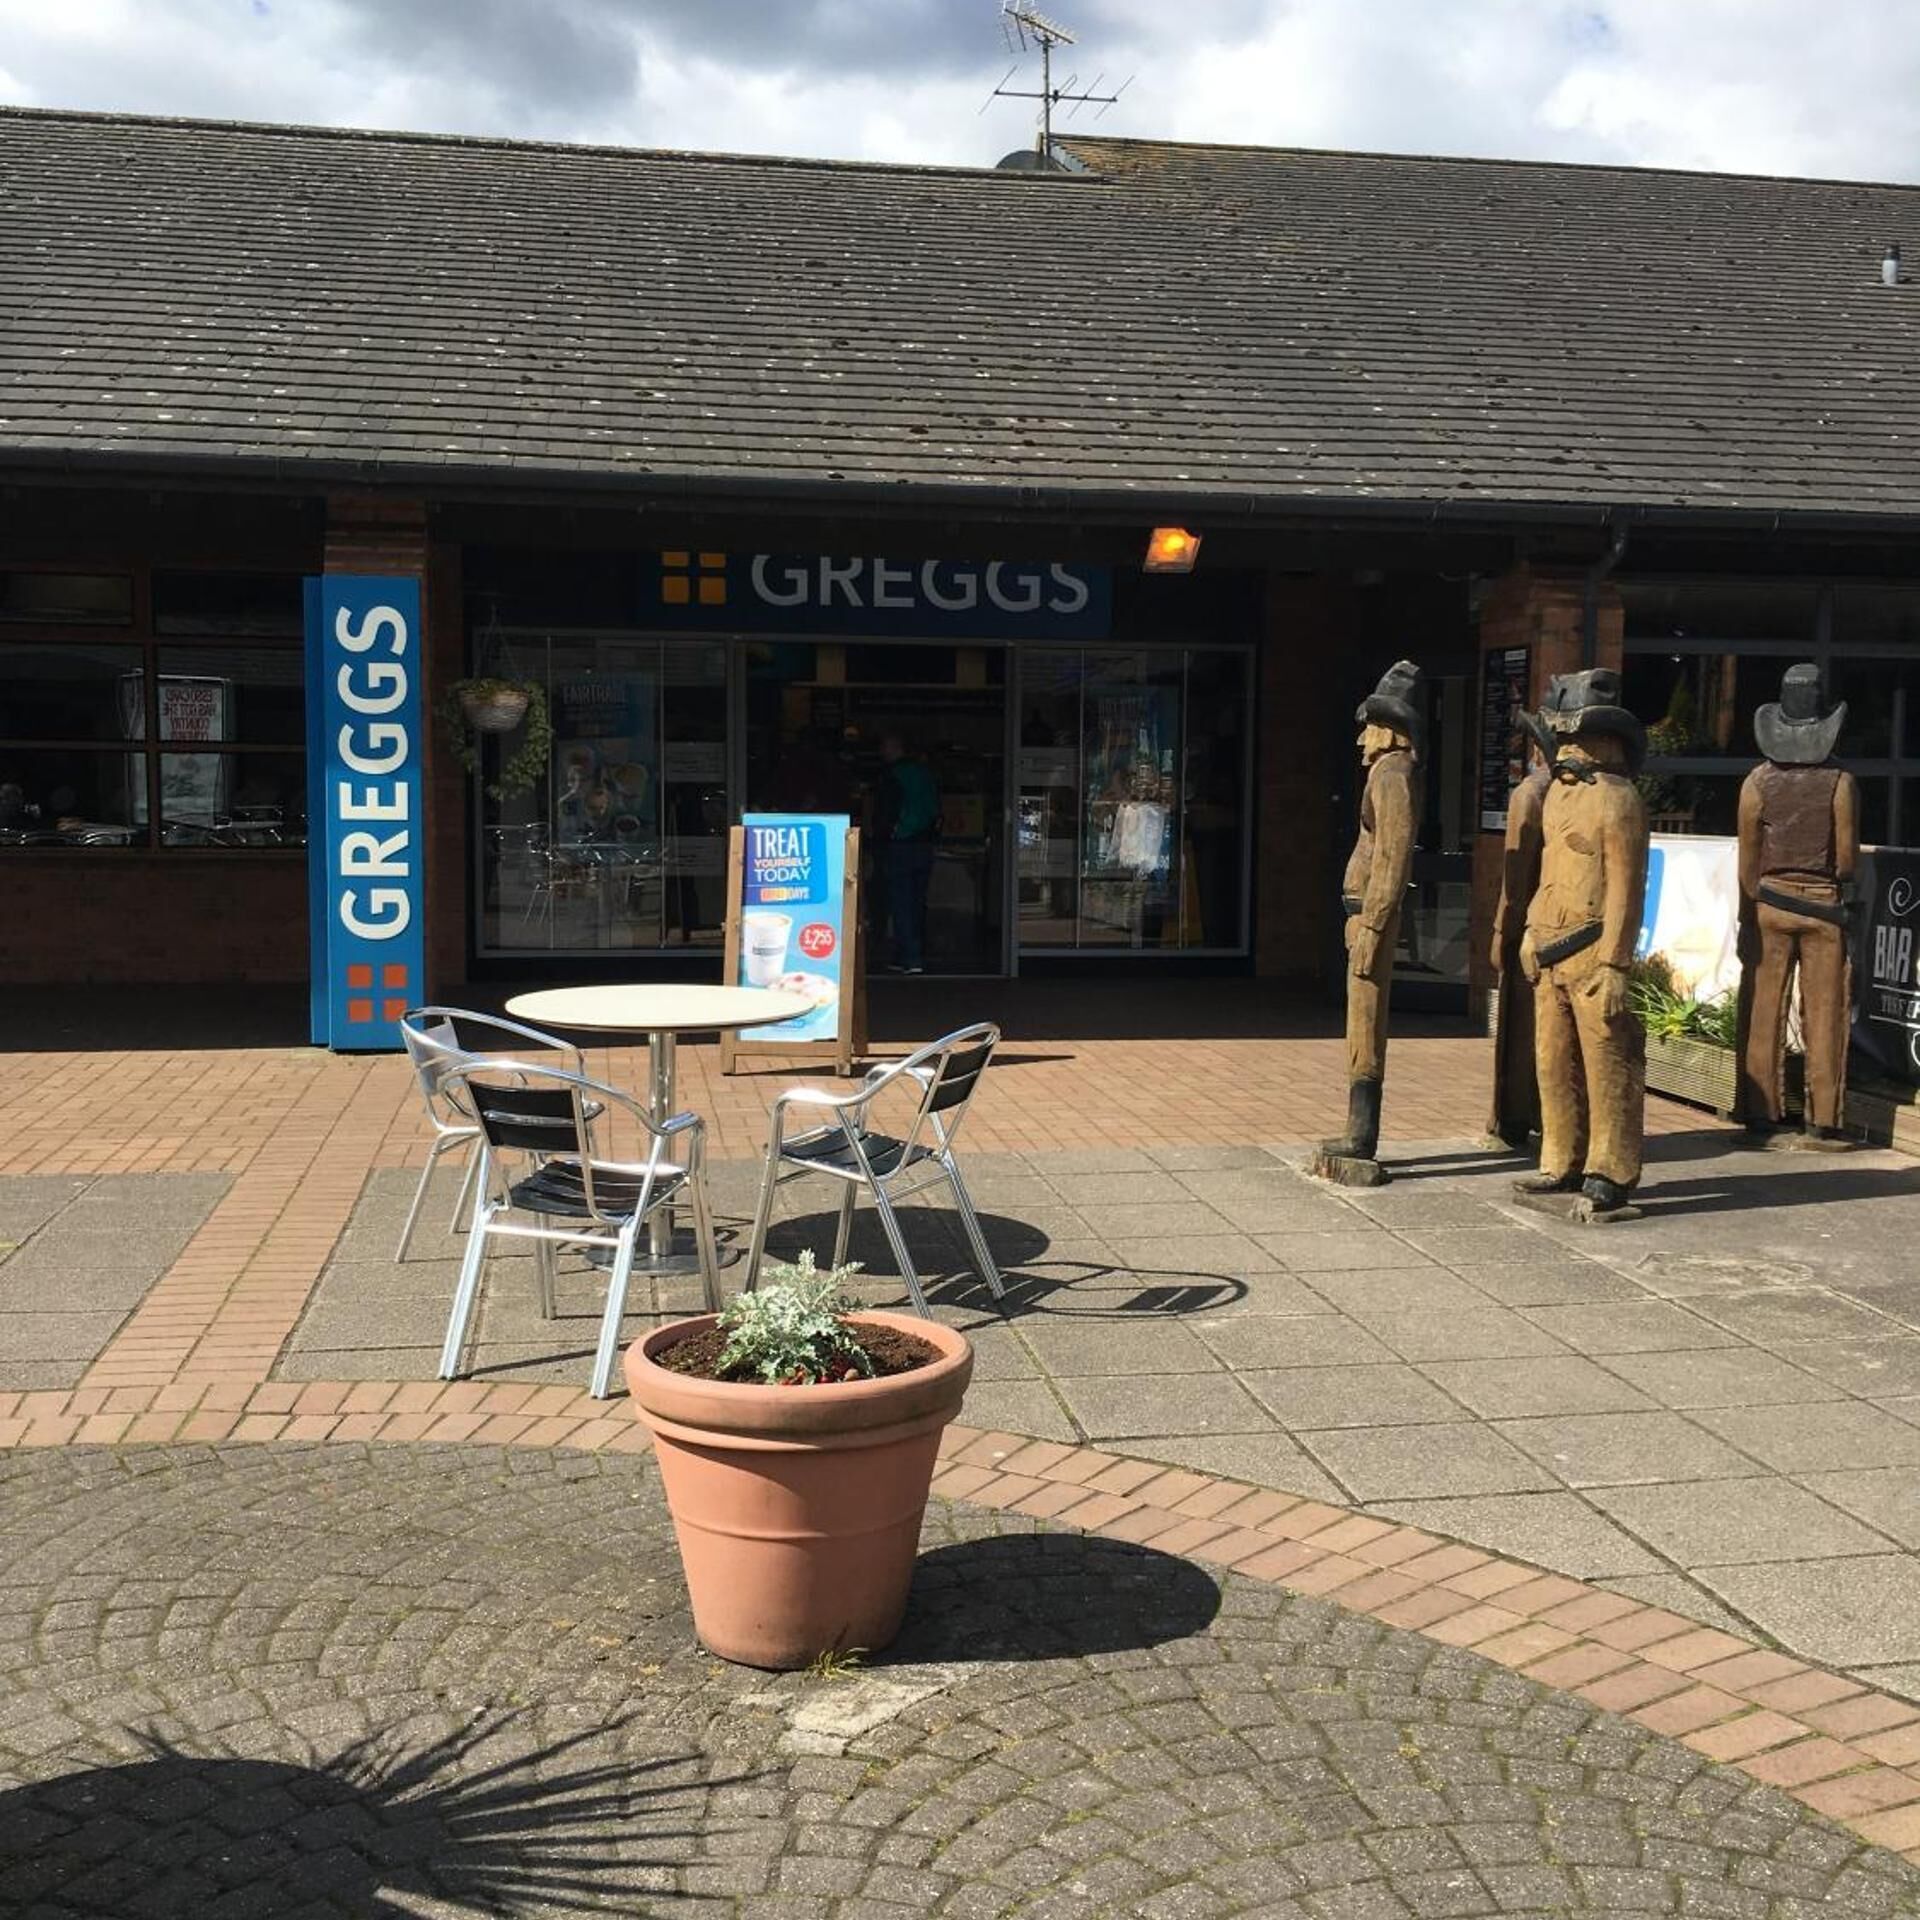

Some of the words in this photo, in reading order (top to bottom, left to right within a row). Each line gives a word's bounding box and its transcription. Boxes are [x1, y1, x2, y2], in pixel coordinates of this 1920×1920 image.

[751, 554, 1090, 614] GREGGS
[335, 604, 410, 941] GREGGS
[753, 827, 811, 858] TREAT
[753, 857, 812, 869] YOURSELF
[753, 867, 811, 882] TODAY
[1873, 924, 1913, 983] BAR
